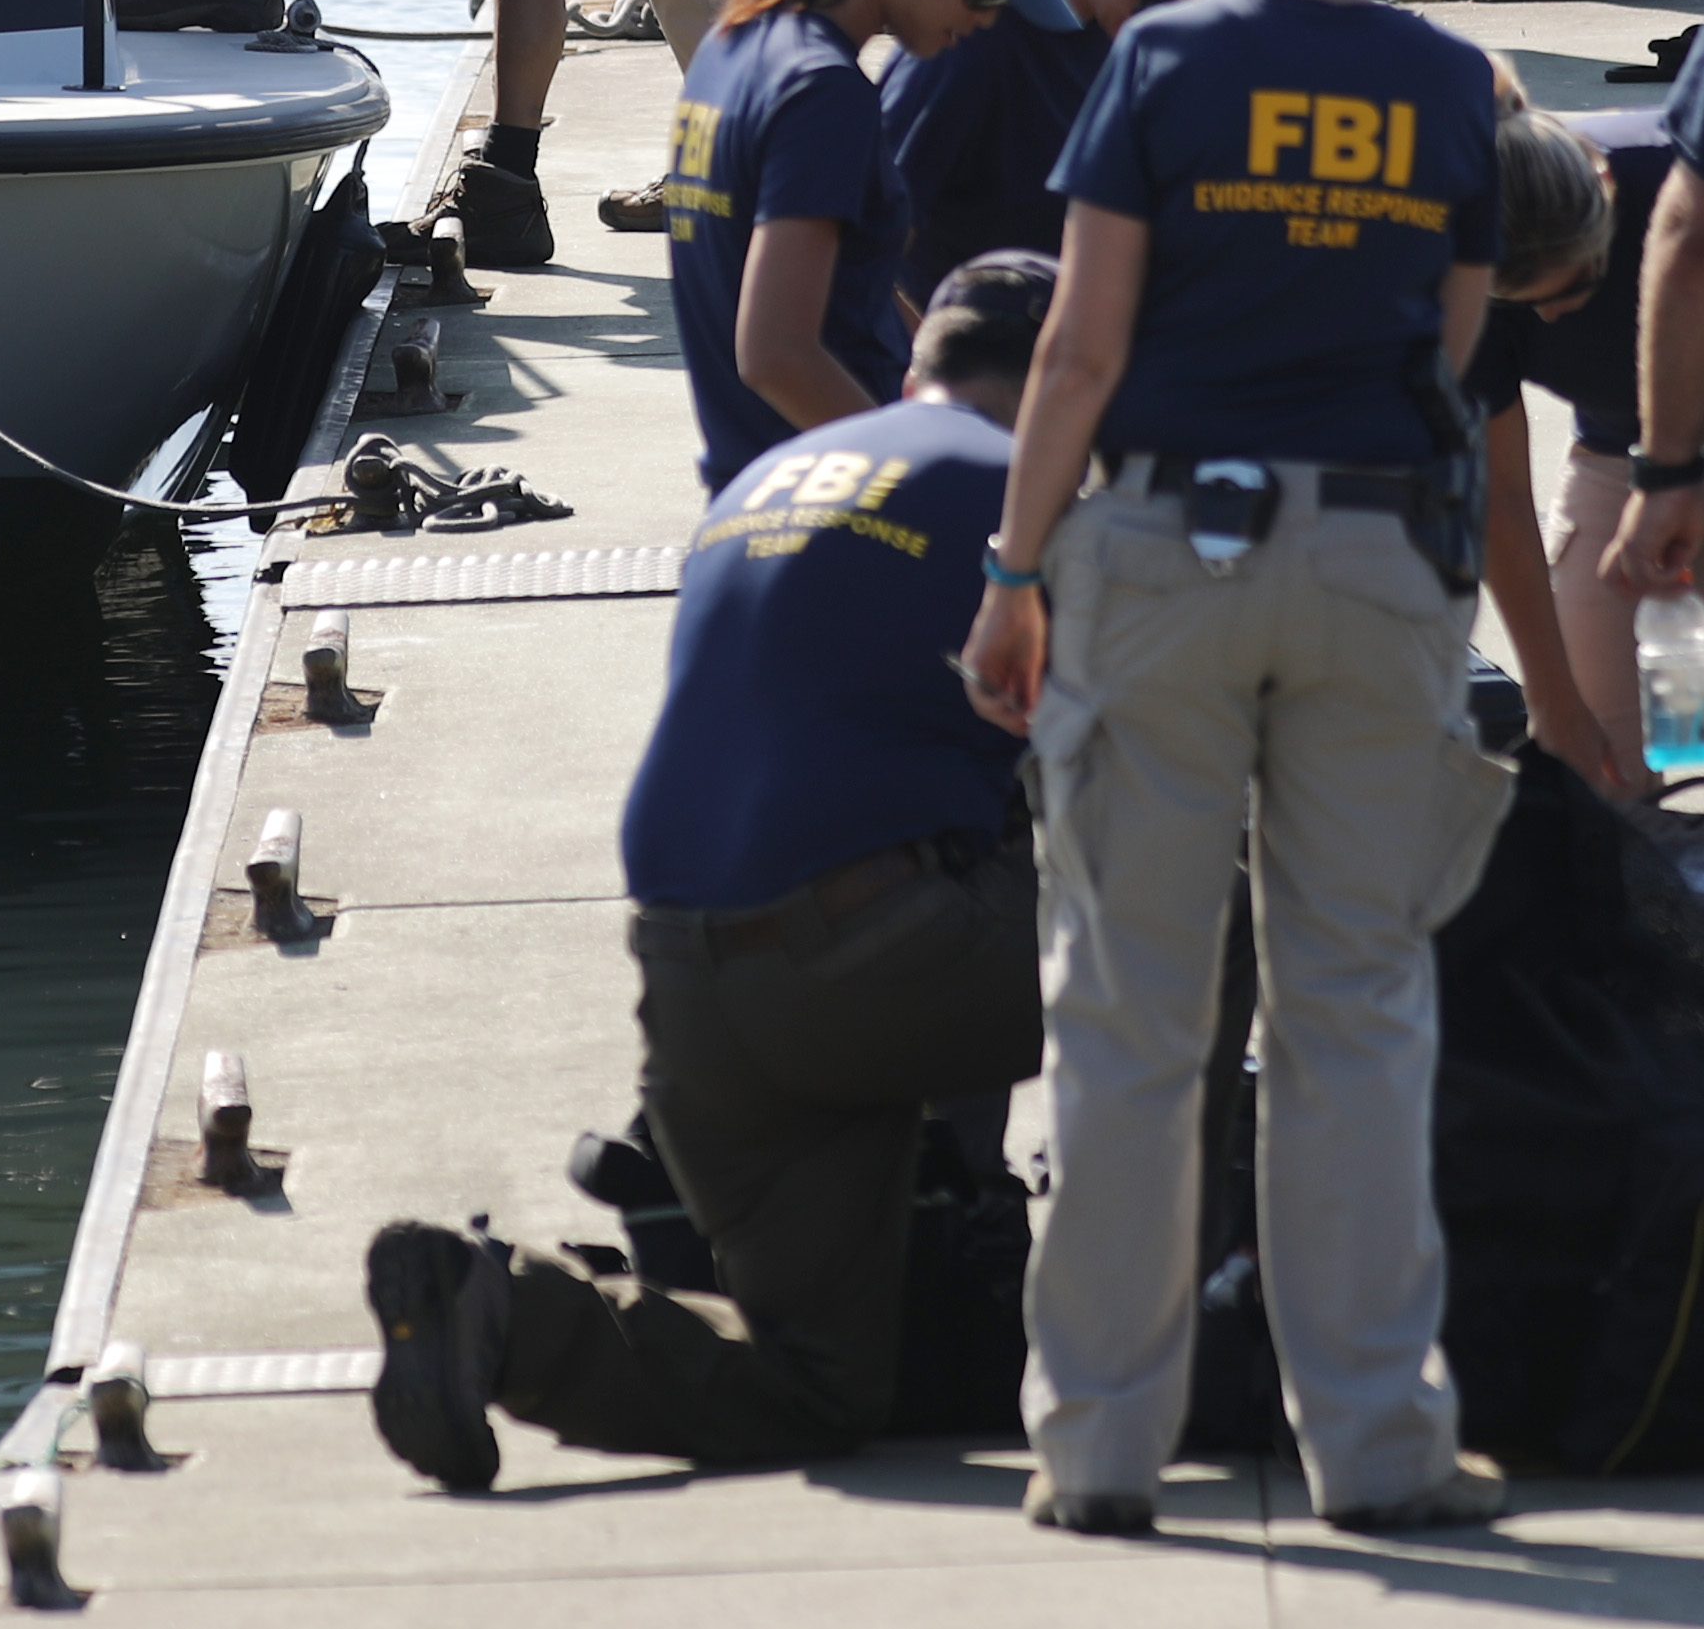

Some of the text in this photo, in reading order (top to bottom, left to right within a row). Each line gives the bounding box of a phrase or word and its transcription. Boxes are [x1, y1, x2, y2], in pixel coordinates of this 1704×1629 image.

[671, 101, 723, 181] FBI
[1248, 89, 1416, 189] FBI
[1194, 181, 1323, 215] EVIDENCE
[1287, 216, 1359, 249] TEAM
[742, 451, 911, 512] FBI
